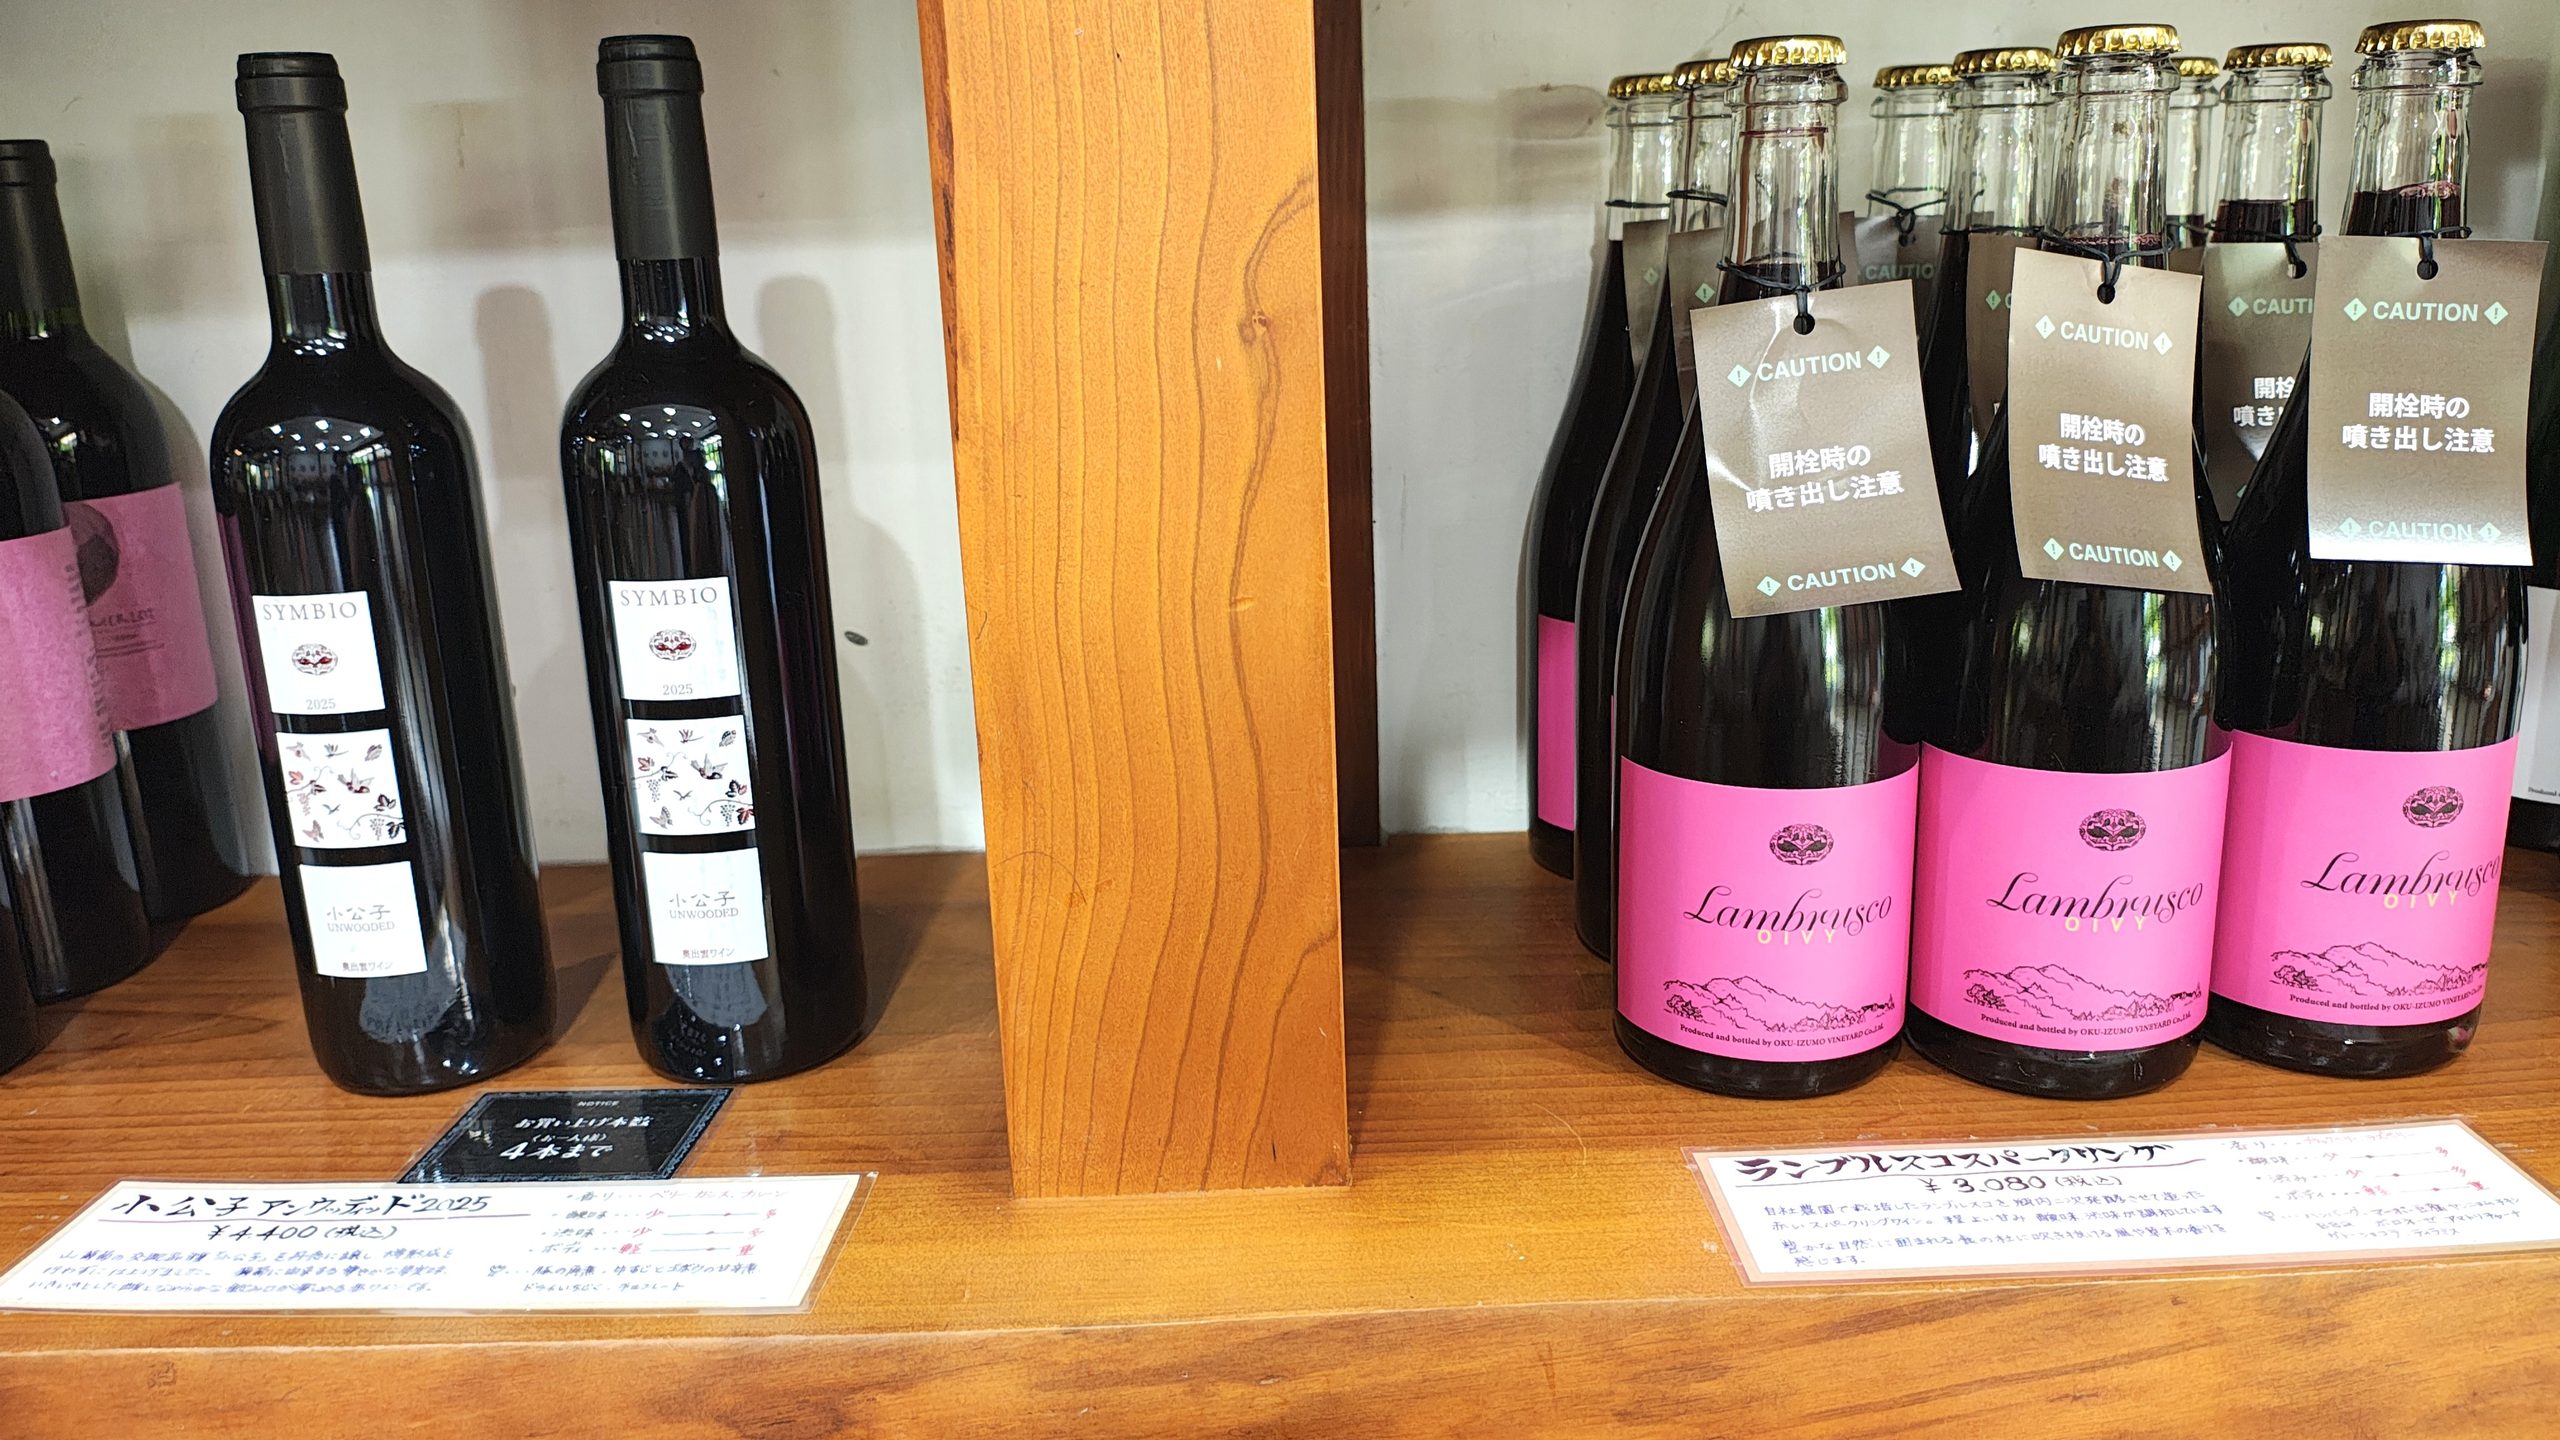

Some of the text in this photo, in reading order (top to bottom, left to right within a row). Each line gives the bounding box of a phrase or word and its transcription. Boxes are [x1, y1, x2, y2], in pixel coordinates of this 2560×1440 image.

[1865, 264, 1933, 280] CAUTIO
[2253, 298, 2314, 316] CAUTI
[2373, 302, 2478, 322] CAUTION
[2060, 320, 2149, 350] CAUTION
[1757, 350, 1862, 383] CAUTION
[2368, 393, 2470, 420] 開栓時の
[2060, 412, 2145, 446] 開栓時の
[2342, 425, 2495, 454] 噴き出し注意
[1768, 445, 1871, 480] 開栓時の
[2039, 443, 2168, 482] 噴き出し注意
[1746, 471, 1905, 512] 噴き出し注意
[2369, 520, 2473, 542] CAUTION
[2068, 542, 2160, 568] CAUTION
[1787, 562, 1896, 592] CAUTION
[620, 586, 718, 607] SYMBIO
[263, 601, 357, 621] SYMBIO
[662, 683, 694, 696] 2025
[305, 698, 337, 711] 2025
[2300, 849, 2501, 898] Lambrusco
[669, 890, 736, 907] 小公子
[1986, 872, 2204, 924] Lambrusco
[2383, 892, 2458, 910] OIVY
[326, 904, 391, 921] 小公子
[669, 907, 739, 919] UNWOODED
[1683, 885, 1892, 937] Lambrusco
[327, 921, 396, 933] UNWOODED
[2065, 915, 2148, 933] OIVY
[1757, 928, 1836, 945] OIVY
[682, 947, 735, 960] 奥出雲ワイン
[342, 961, 393, 972] 奥出雲ワイン
[2290, 994, 2329, 1008] Produced
[2332, 1000, 2348, 1009] and
[2350, 1001, 2379, 1011] bottled
[2381, 1003, 2391, 1012] by
[2393, 999, 2441, 1011] OKU-IZUMO
[1980, 1013, 2017, 1029] Produced
[2019, 1021, 2035, 1031] and
[2037, 1024, 2067, 1035] bottled
[2068, 1027, 2078, 1037] by
[2080, 1026, 2134, 1036] OKU-IZUMO
[2135, 1019, 2172, 1033] VINEYARD
[1680, 1023, 1714, 1039] Produced
[1716, 1032, 1730, 1042] and
[1732, 1034, 1760, 1046] bottled
[1762, 1038, 1772, 1048] by
[1774, 1038, 1825, 1047] OKU-IZUMO
[1827, 1030, 1863, 1045] VINEYARD
[514, 1115, 655, 1129] お買い上げ本数
[499, 1141, 614, 1161] 4本まで
[1735, 1143, 2173, 1181] ランブルスコスパークリング
[2055, 1173, 2123, 1189] (税込)
[324, 1224, 398, 1241] (税込)
